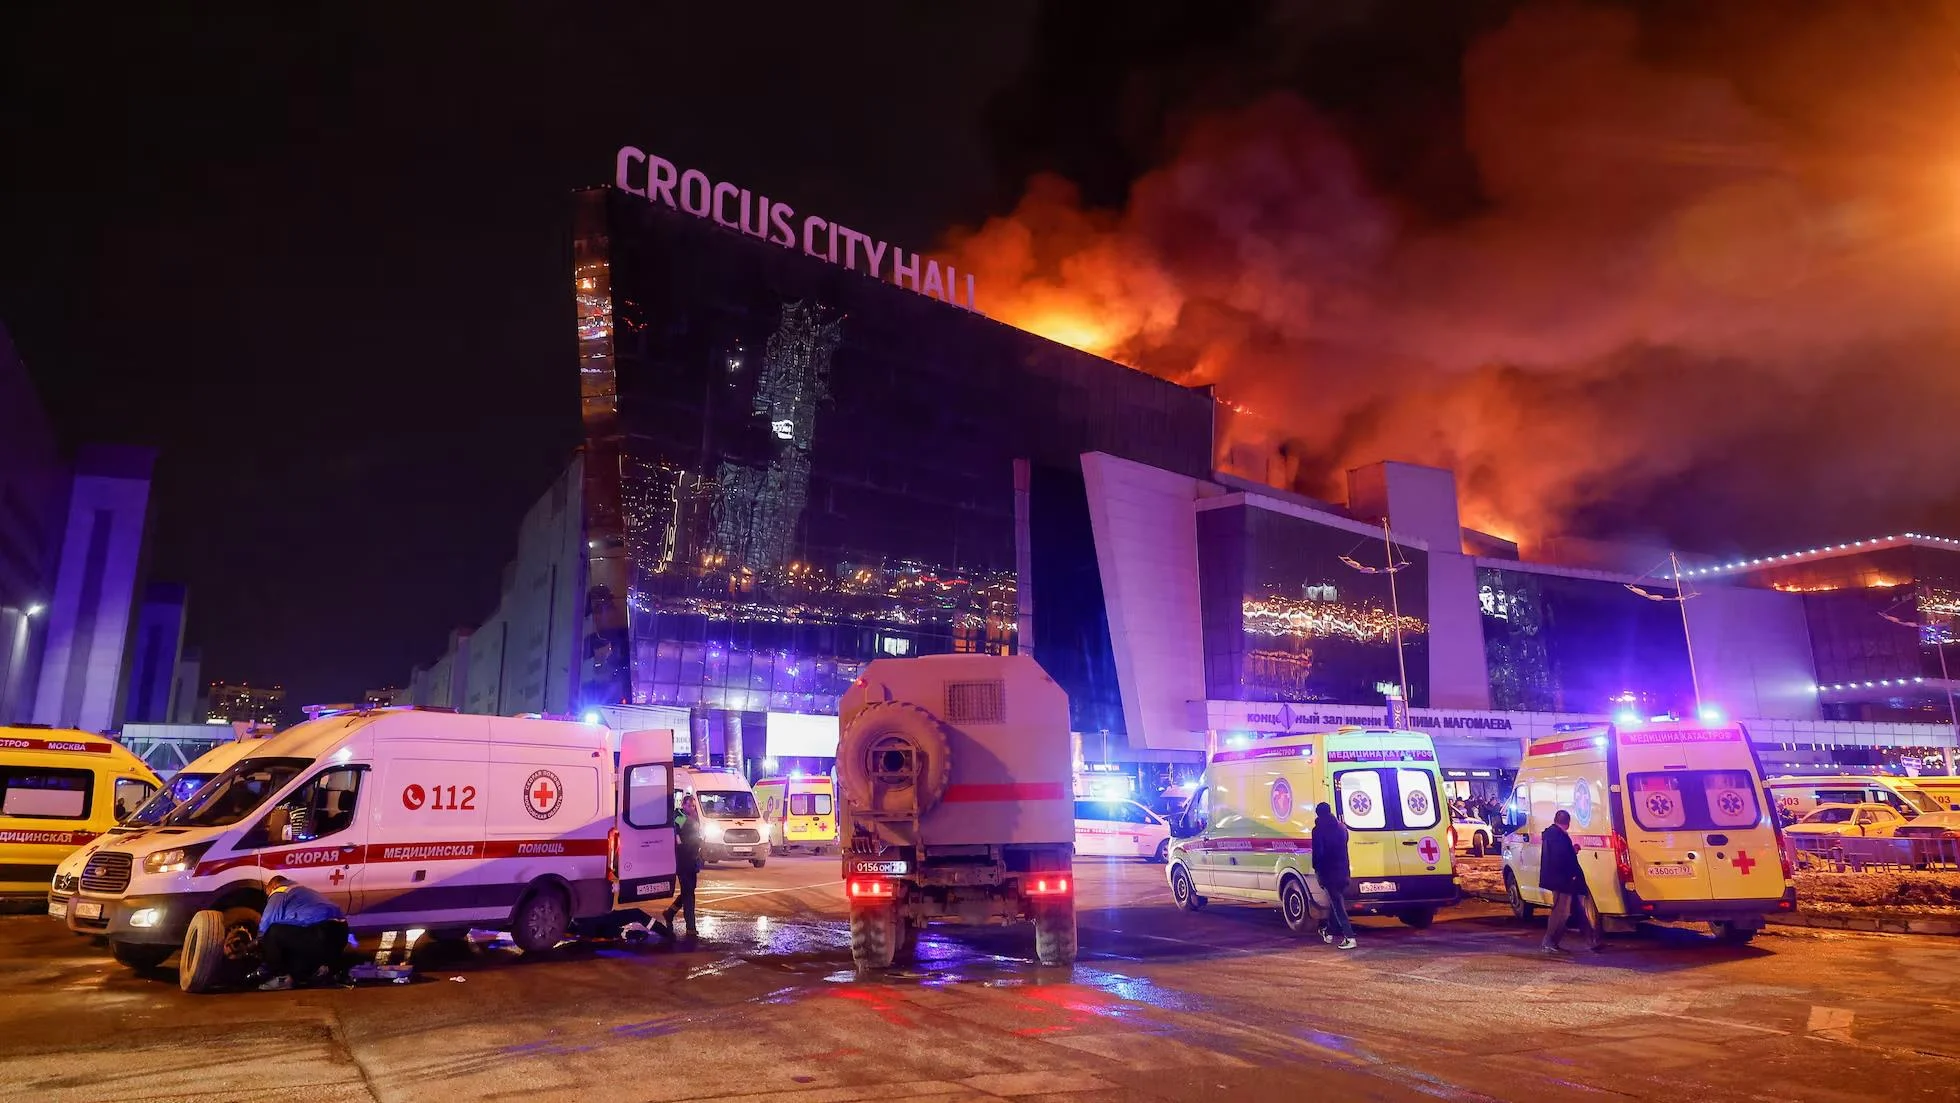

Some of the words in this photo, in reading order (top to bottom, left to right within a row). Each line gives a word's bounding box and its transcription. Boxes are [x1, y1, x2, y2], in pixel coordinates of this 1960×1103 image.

[616, 146, 796, 248] CROCUS
[803, 216, 888, 278] CITY
[893, 247, 987, 315] HALL
[1322, 715, 1343, 725] зал
[1345, 715, 1381, 727] имени
[1443, 717, 1512, 730] МАГОМАЕВА
[1631, 733, 1679, 743] МЕДИЦИНА
[48, 742, 86, 750] МОСКВА
[1328, 750, 1382, 759] МЕДИЦИНА
[1383, 750, 1432, 758] КАТАСТРОФ
[431, 785, 476, 810] 112
[1782, 797, 1799, 805] 103
[285, 851, 339, 865] СКОРАЯ
[384, 845, 474, 860] МЕДИЦИНСКАЯ
[518, 843, 565, 855] ПОМОЩЬ
[857, 863, 878, 872] 0156
